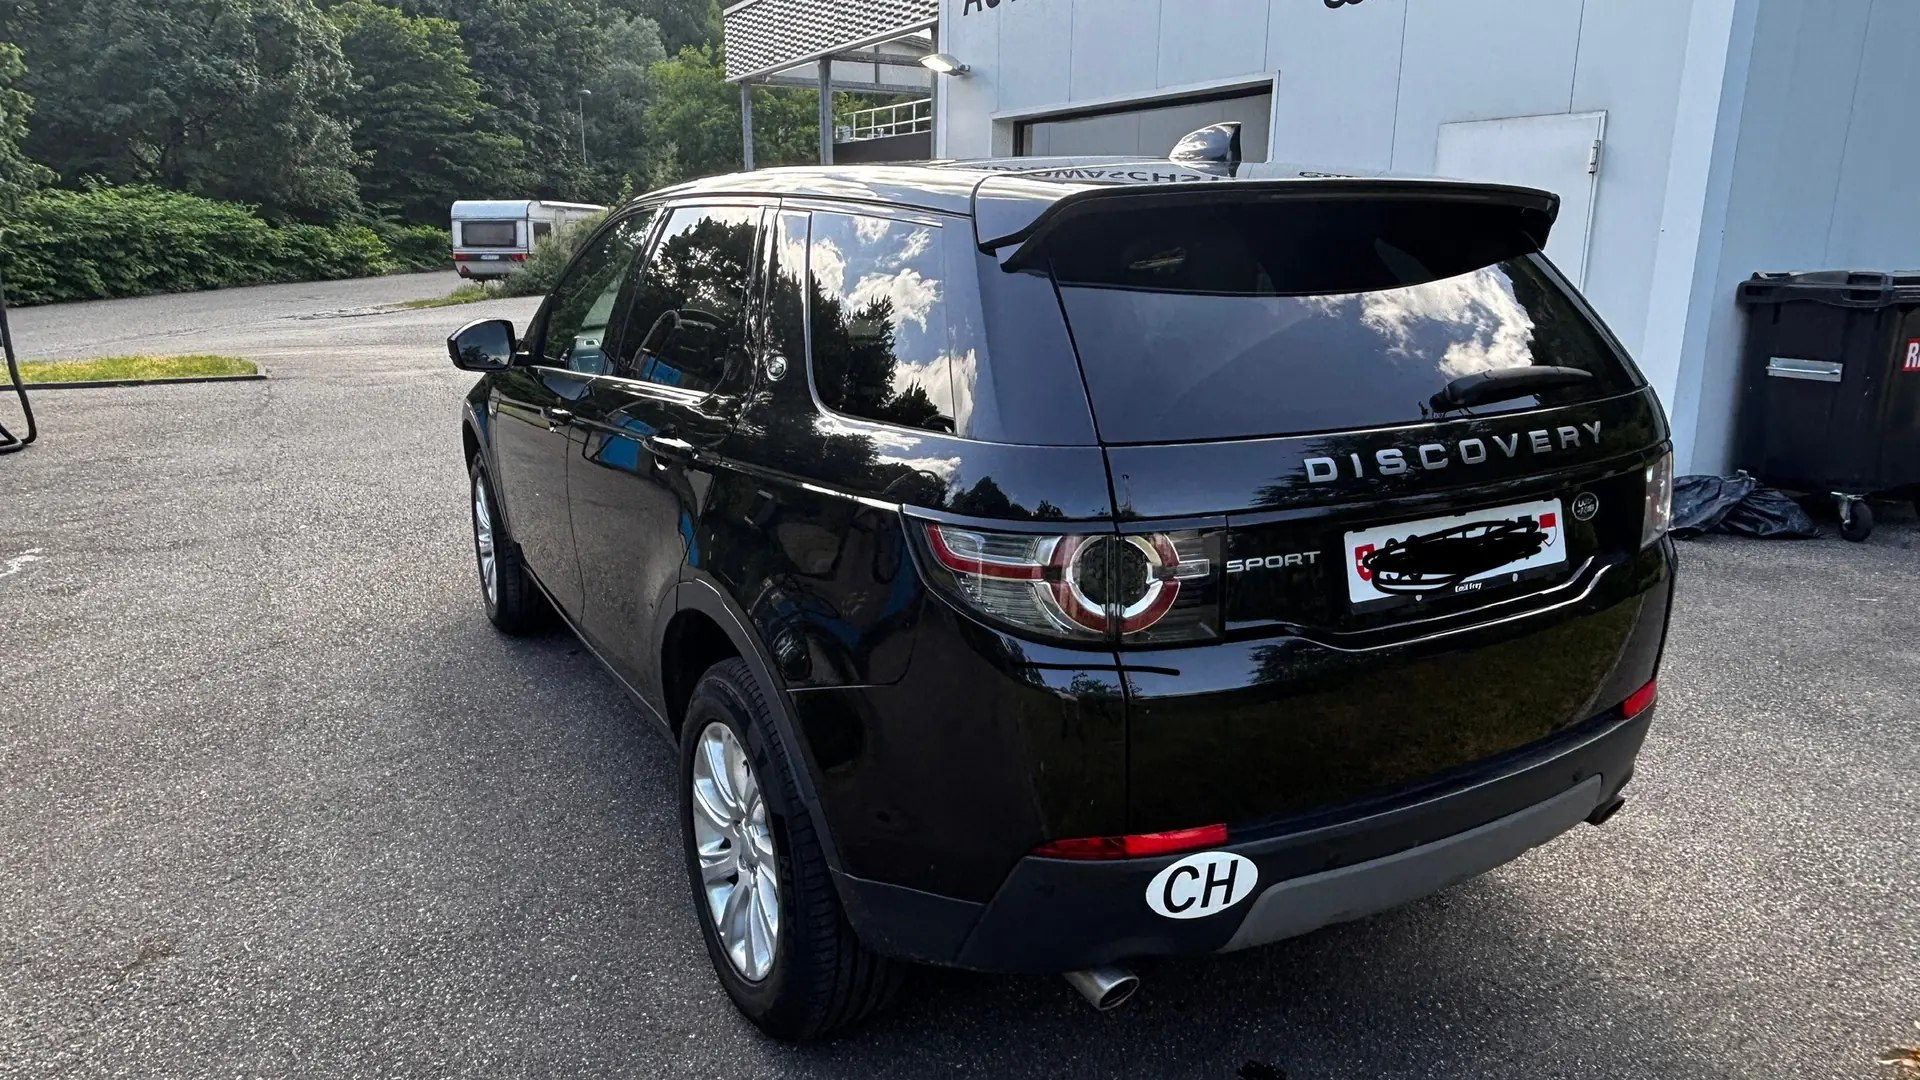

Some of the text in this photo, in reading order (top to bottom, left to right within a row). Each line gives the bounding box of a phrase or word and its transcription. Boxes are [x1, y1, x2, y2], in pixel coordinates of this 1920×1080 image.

[1905, 342, 1920, 368] R
[1303, 420, 1602, 483] DISCOVERY
[1226, 550, 1321, 573] SPORT
[1163, 859, 1239, 913] CH
